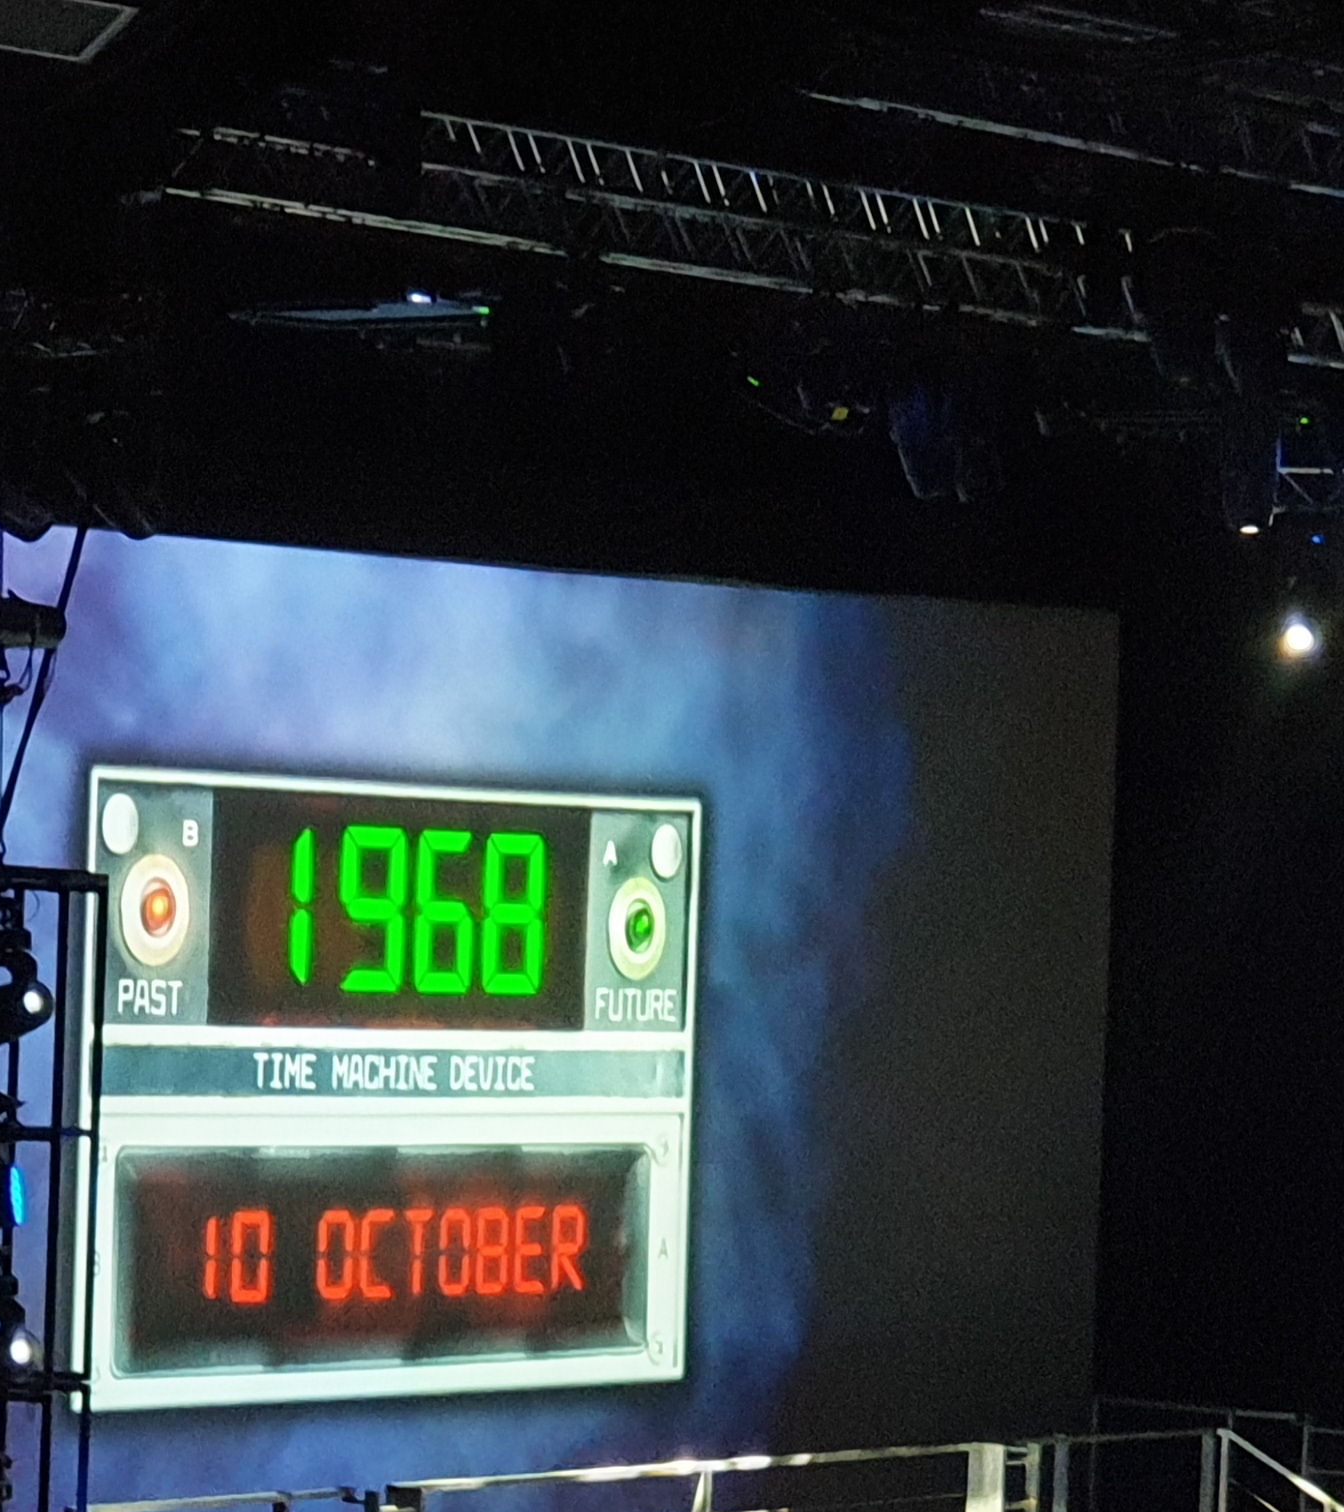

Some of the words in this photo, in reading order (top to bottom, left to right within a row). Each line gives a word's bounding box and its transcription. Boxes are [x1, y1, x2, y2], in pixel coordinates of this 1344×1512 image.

[182, 819, 199, 847] B
[602, 840, 618, 867] A
[288, 824, 546, 996] 1968
[117, 978, 184, 1017] PAST
[594, 986, 678, 1023] FUTURE
[253, 1052, 317, 1090] TIME
[332, 1053, 438, 1091] MACHINE
[449, 1054, 536, 1091] DEVICE
[203, 1207, 272, 1305] 10
[315, 1203, 587, 1301] OCTOBER
